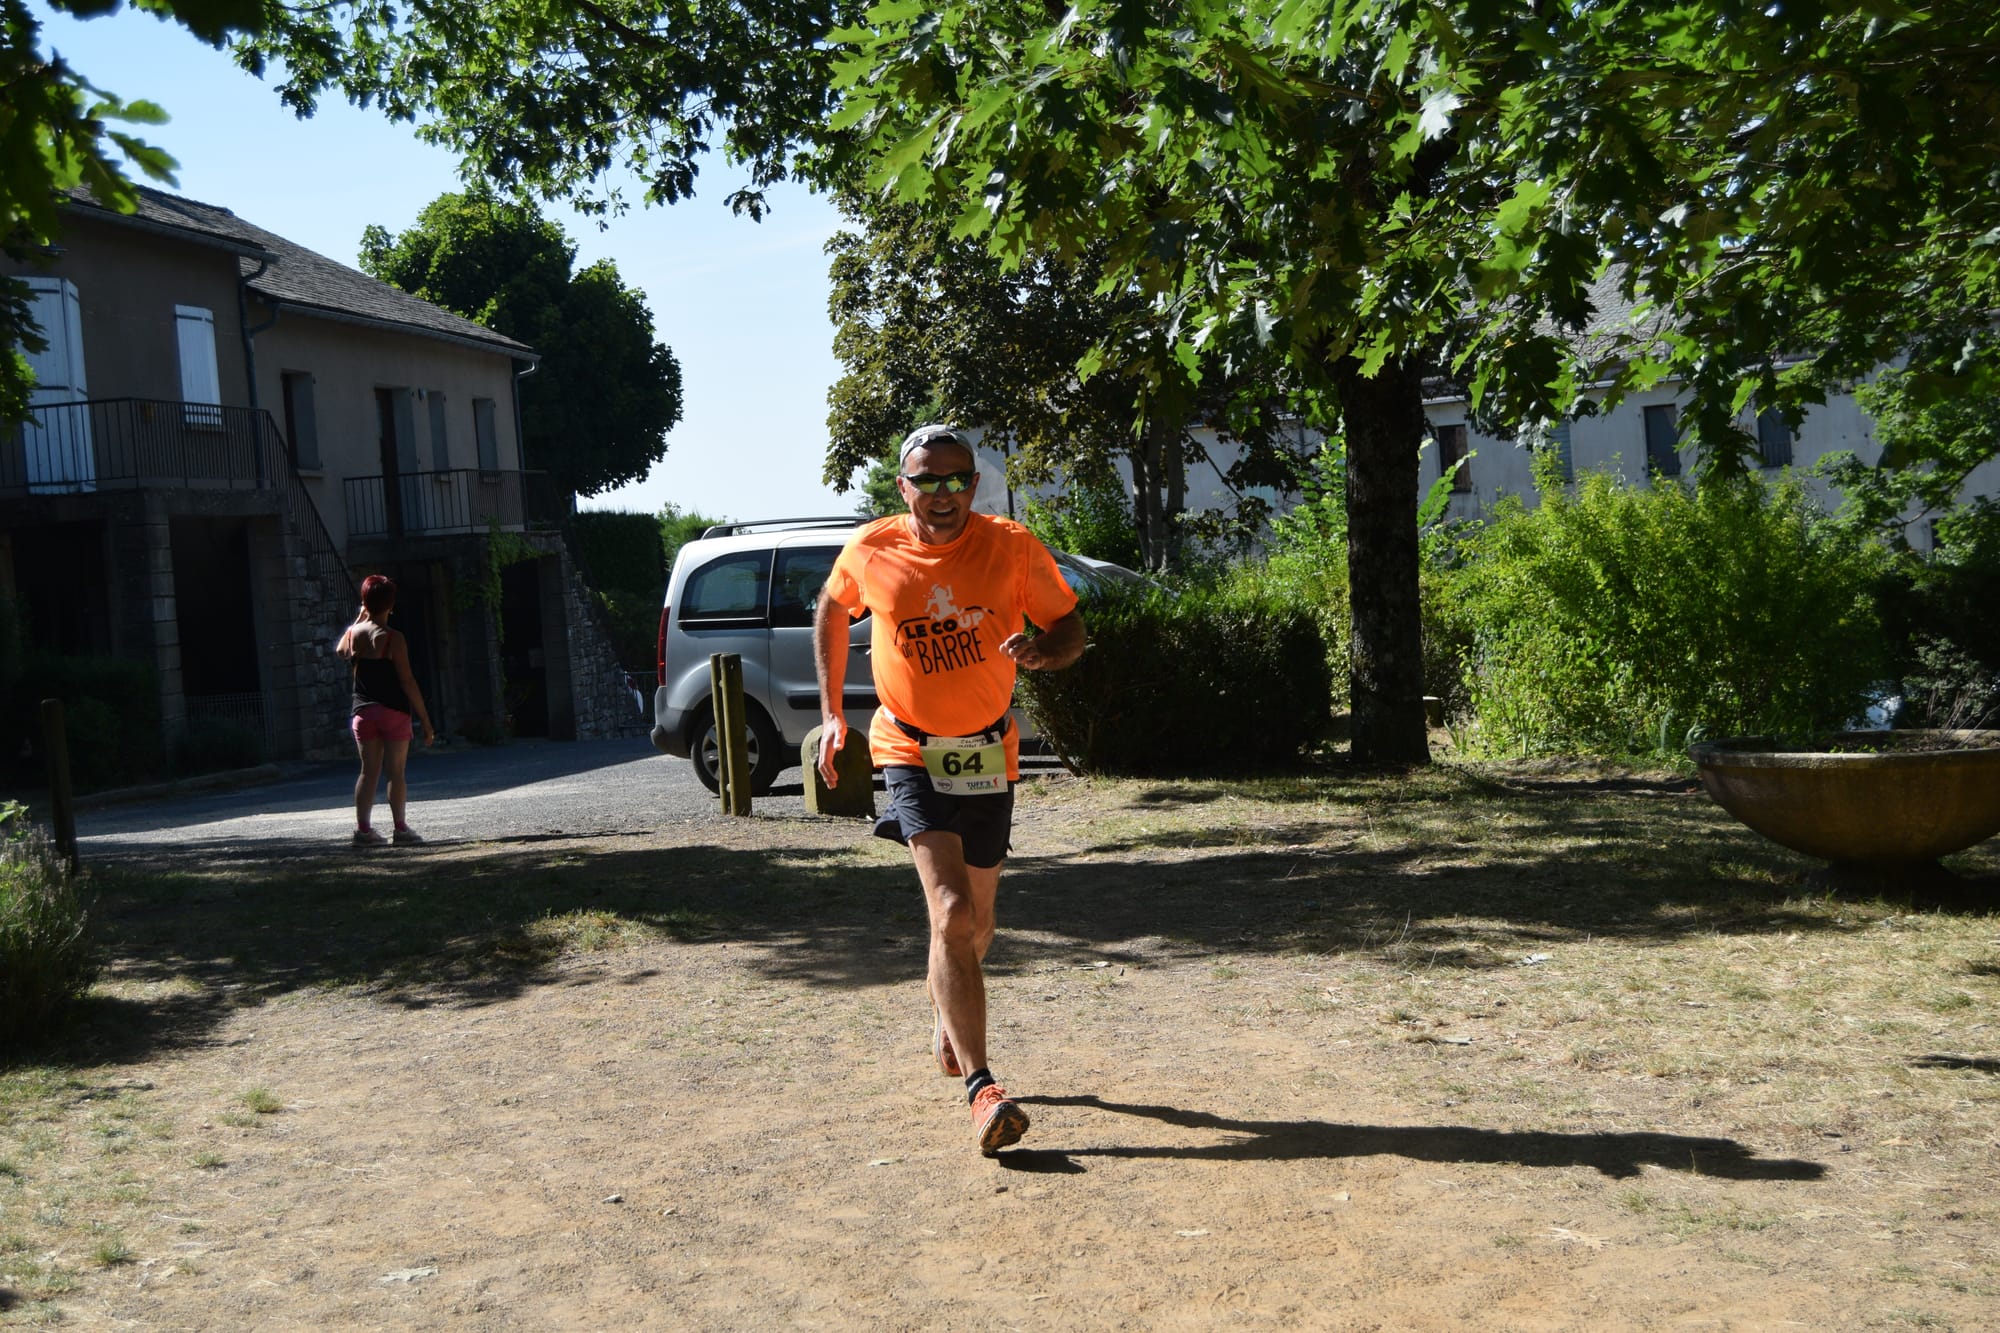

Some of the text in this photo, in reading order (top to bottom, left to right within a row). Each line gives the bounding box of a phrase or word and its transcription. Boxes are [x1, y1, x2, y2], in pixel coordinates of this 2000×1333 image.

[904, 611, 984, 639] LE COUP
[915, 627, 986, 675] BARRE
[942, 751, 984, 776] 64
